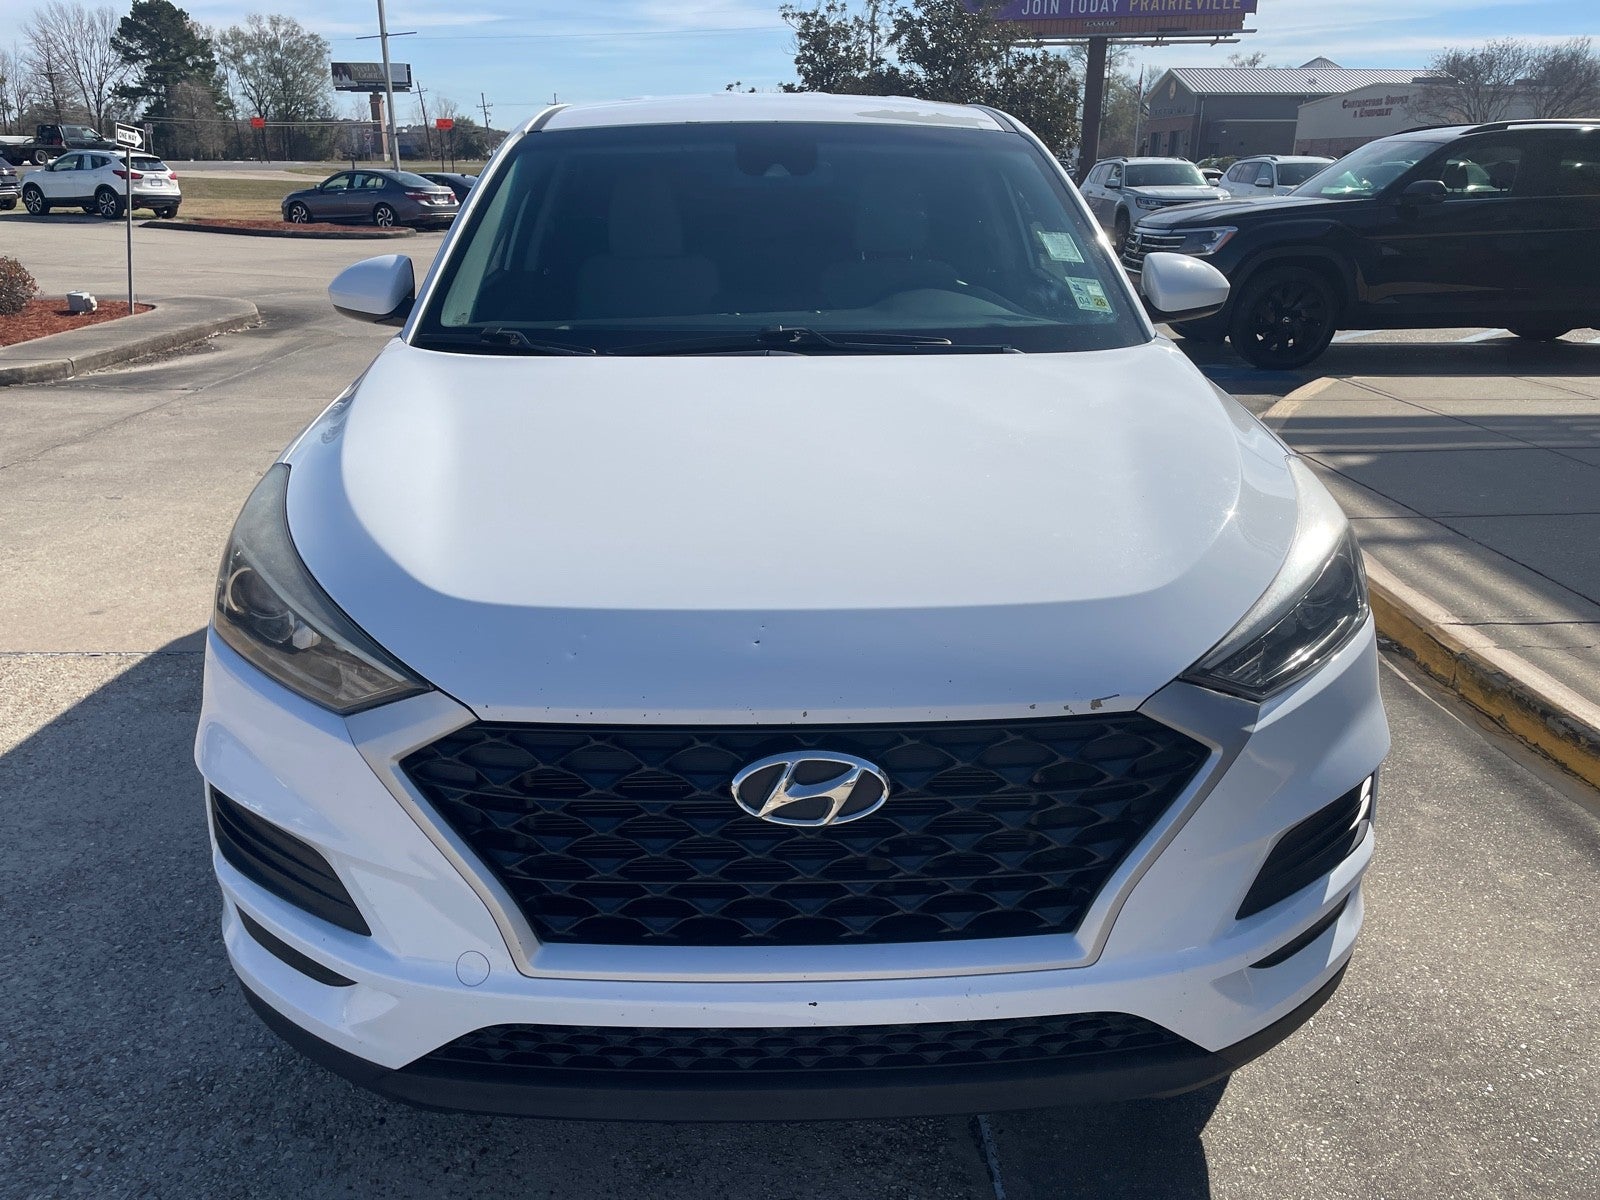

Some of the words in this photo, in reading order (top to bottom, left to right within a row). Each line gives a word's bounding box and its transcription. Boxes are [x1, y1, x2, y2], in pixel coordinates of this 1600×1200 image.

[1021, 0, 1060, 15] JOIN
[1069, 0, 1119, 14] TODAY
[1129, 0, 1241, 11] PRAIRIEVILLE
[119, 131, 128, 140] ONE
[128, 134, 137, 142] WAY
[1094, 297, 1106, 307] 26
